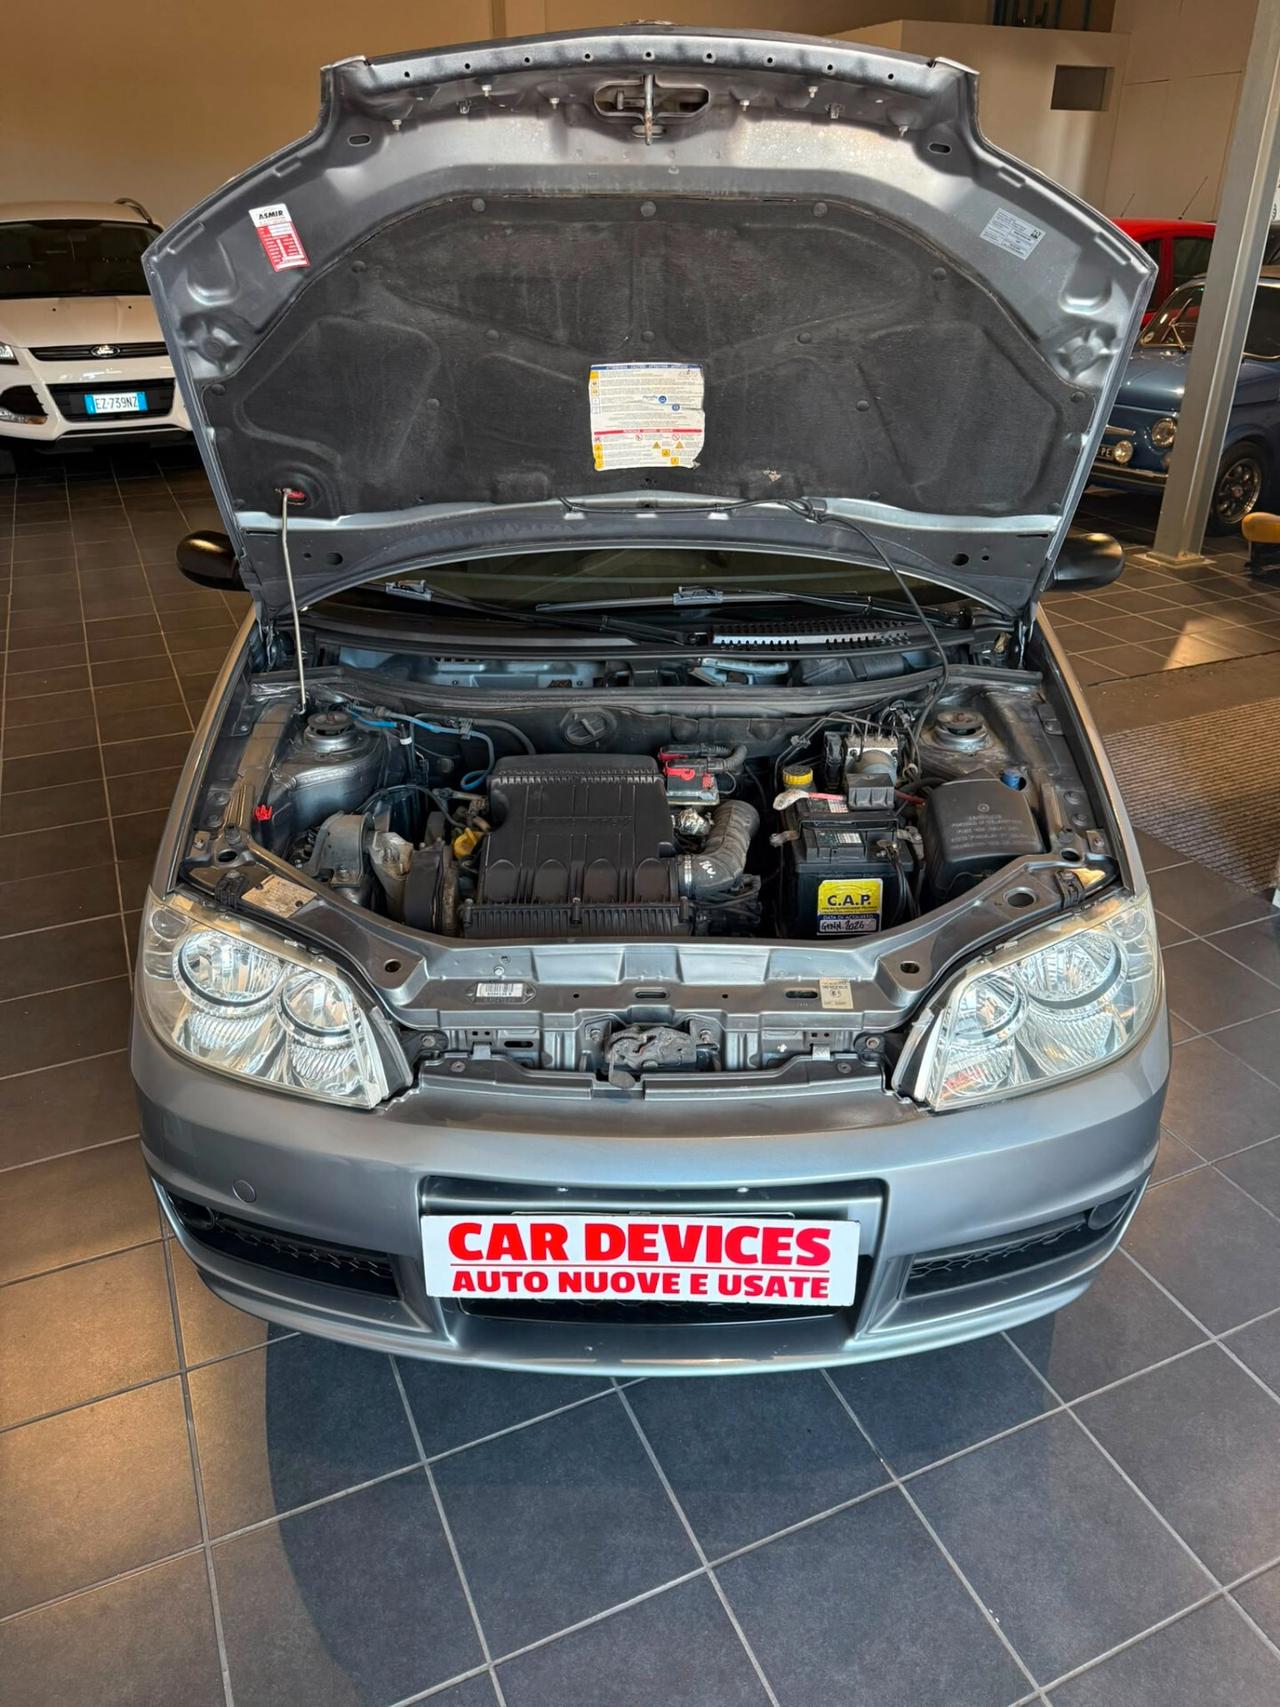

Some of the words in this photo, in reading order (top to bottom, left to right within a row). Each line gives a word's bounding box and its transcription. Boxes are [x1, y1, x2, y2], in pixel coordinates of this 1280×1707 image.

[827, 894, 871, 906] C.A.P.
[449, 1223, 568, 1261] CAR
[585, 1223, 830, 1266] DEVICES
[453, 1271, 548, 1293] AUTO
[559, 1272, 680, 1294] NUOVE
[690, 1273, 708, 1295] E
[719, 1274, 829, 1299] USATE
